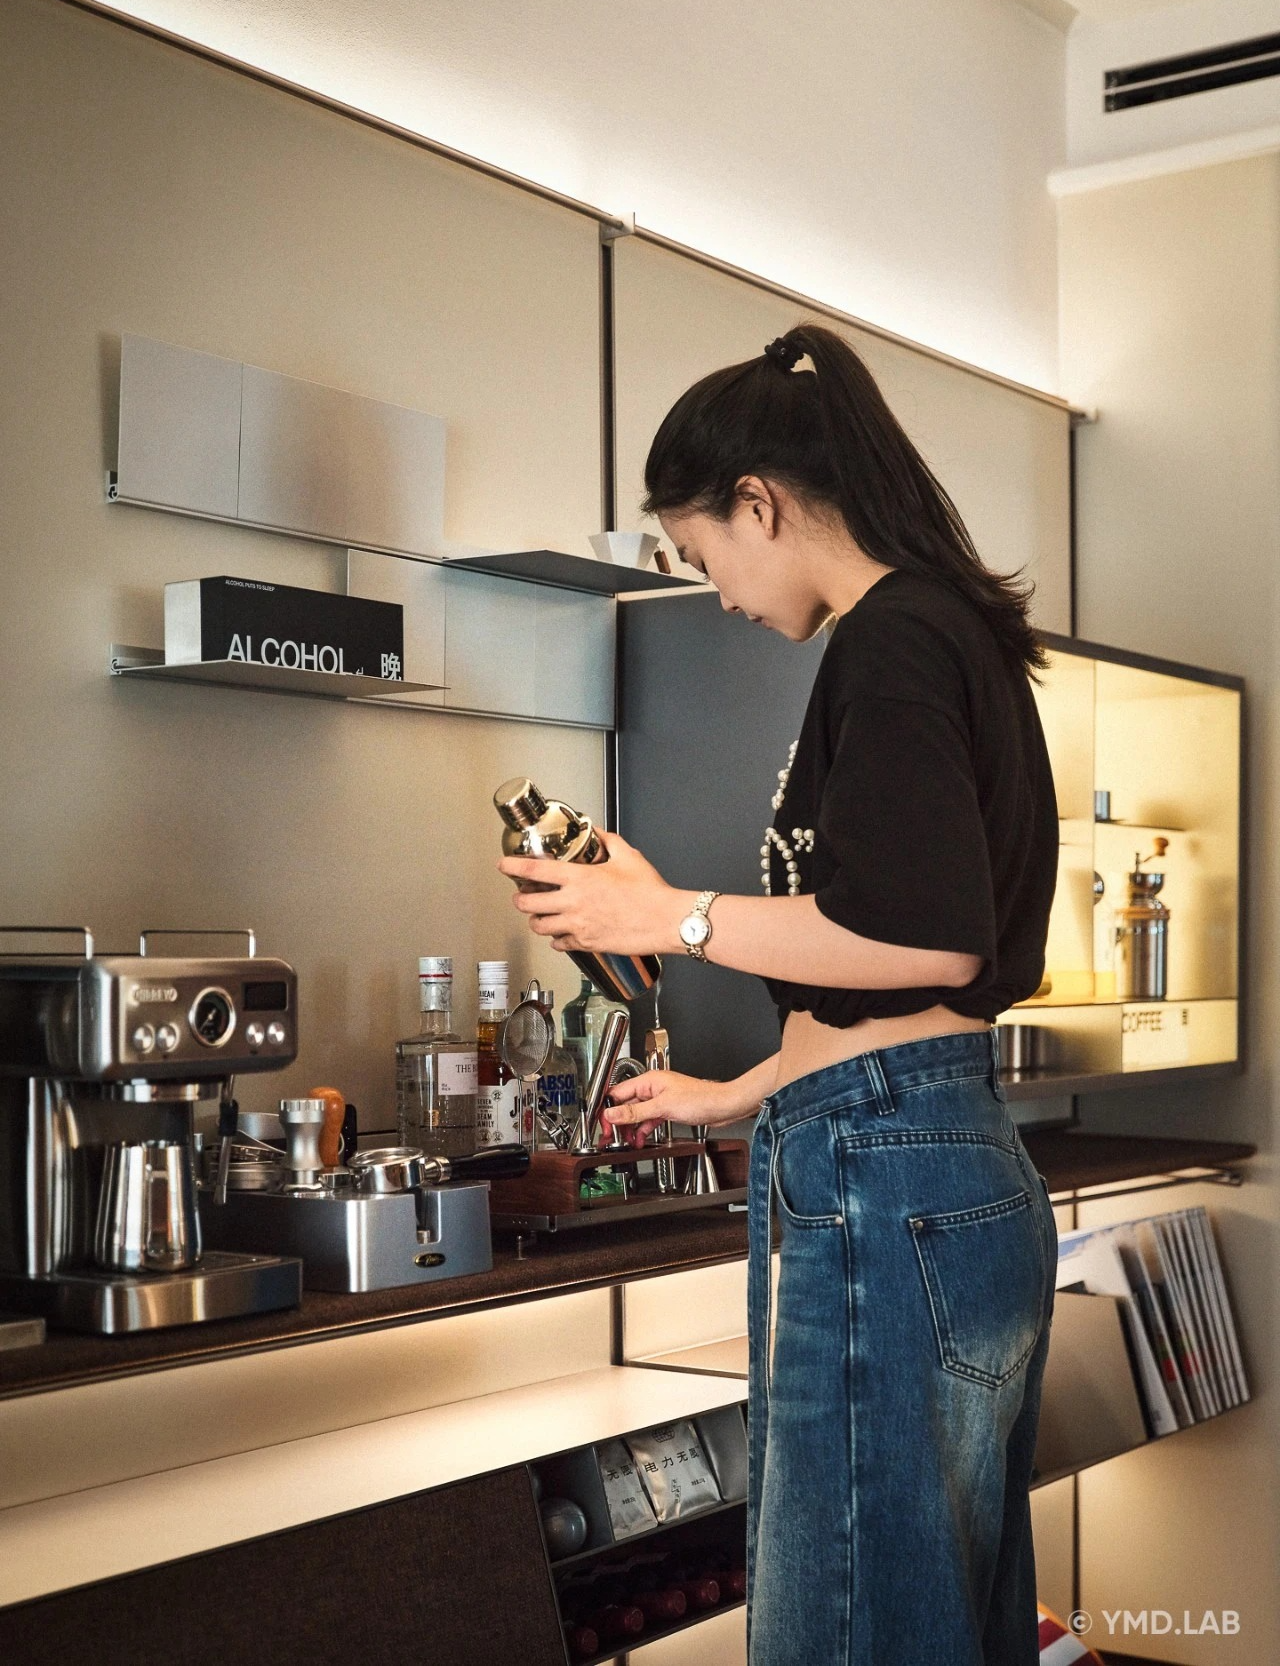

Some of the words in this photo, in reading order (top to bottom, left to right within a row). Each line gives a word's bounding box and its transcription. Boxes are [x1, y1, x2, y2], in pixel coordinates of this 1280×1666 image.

[225, 579, 244, 588] ALCOHOL
[227, 633, 353, 676] ALCOHOL
[380, 652, 402, 681] 晚
[455, 1063, 471, 1073] THE
